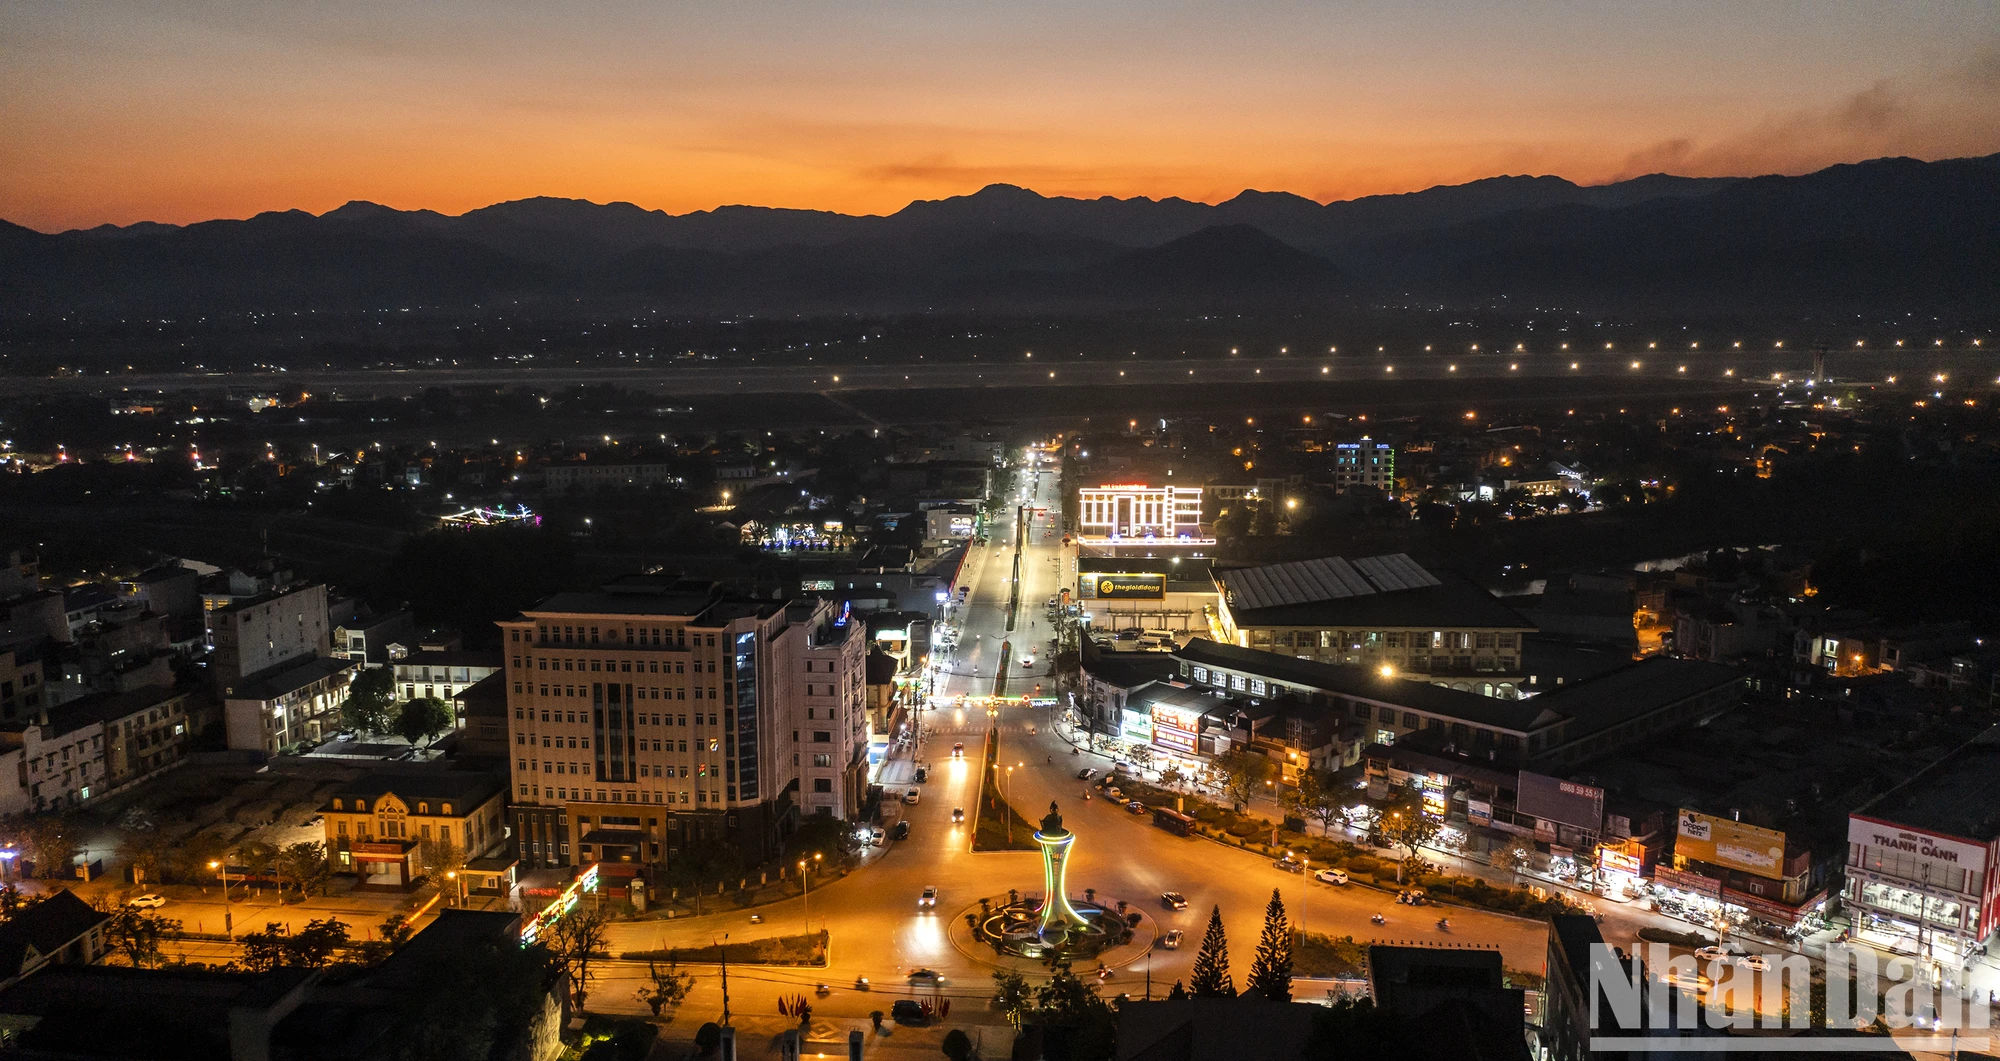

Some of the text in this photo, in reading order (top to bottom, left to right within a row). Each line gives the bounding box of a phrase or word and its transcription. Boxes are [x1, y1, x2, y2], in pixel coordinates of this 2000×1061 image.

[1114, 583, 1160, 592] thegioididong
[1683, 820, 1708, 832] Doppel
[1687, 828, 1703, 837] herz
[1873, 835, 1958, 862] THANH OÁNH
